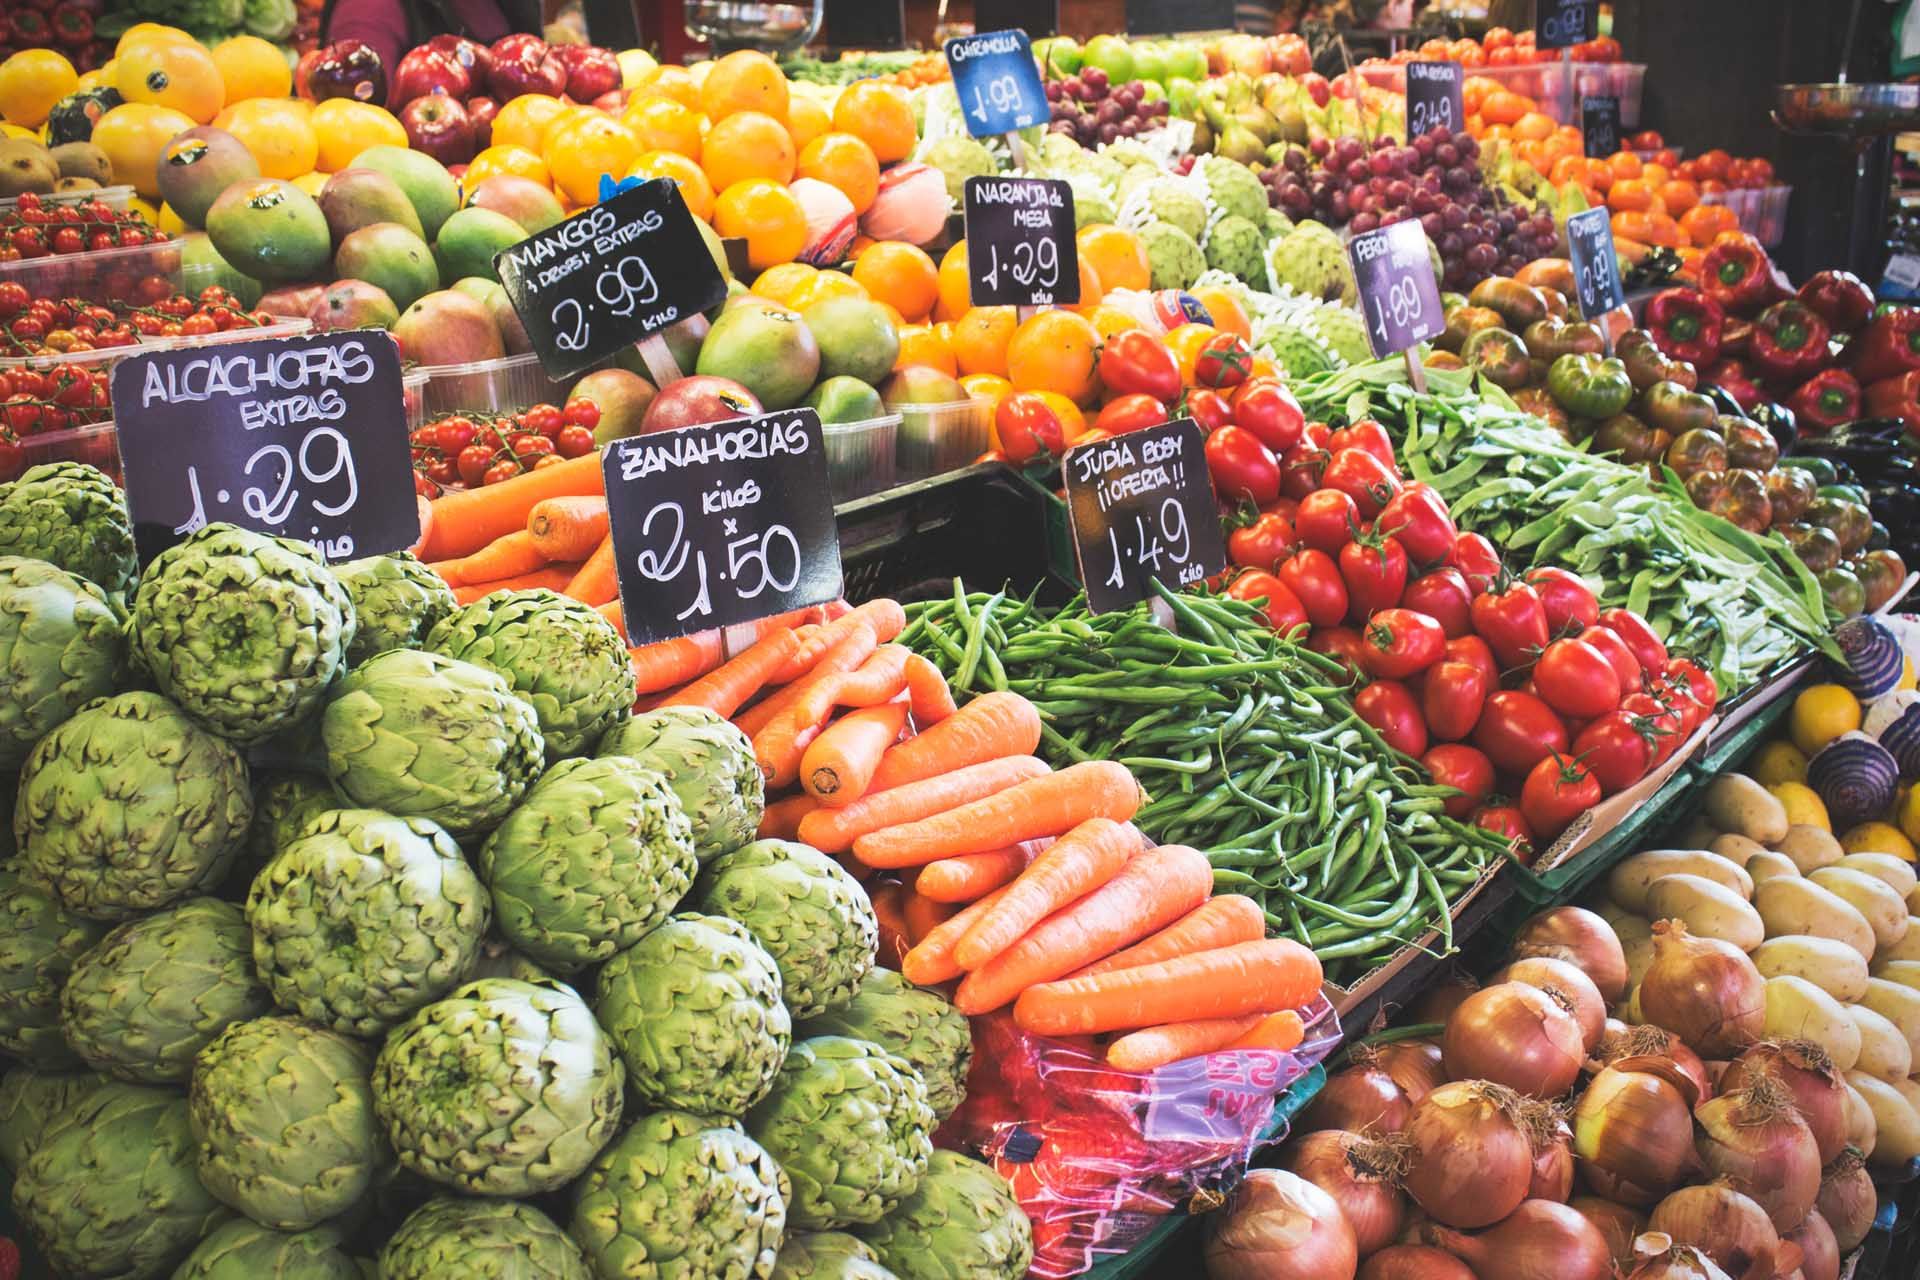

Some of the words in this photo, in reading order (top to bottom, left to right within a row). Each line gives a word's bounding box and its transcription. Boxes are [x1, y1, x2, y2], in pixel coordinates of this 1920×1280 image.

[971, 74, 1023, 123] 1.99
[975, 182, 1049, 208] NARANJA
[1014, 208, 1053, 228] MESA
[508, 207, 617, 278] MANGOS
[593, 209, 664, 257] EXTRAS
[981, 236, 1059, 291] 1.29
[551, 255, 659, 351] 2.99
[641, 306, 679, 331] KILO
[1375, 274, 1423, 342] 1.89
[142, 341, 375, 409] ALCACHOFAS
[240, 388, 347, 431] EXTRAS
[173, 426, 358, 535] 1.29
[619, 418, 809, 481] ZANAHORIAS
[306, 526, 354, 559] ILO
[637, 502, 691, 582] 2
[676, 525, 801, 621] 1.50
[1105, 497, 1190, 589] 1.49
